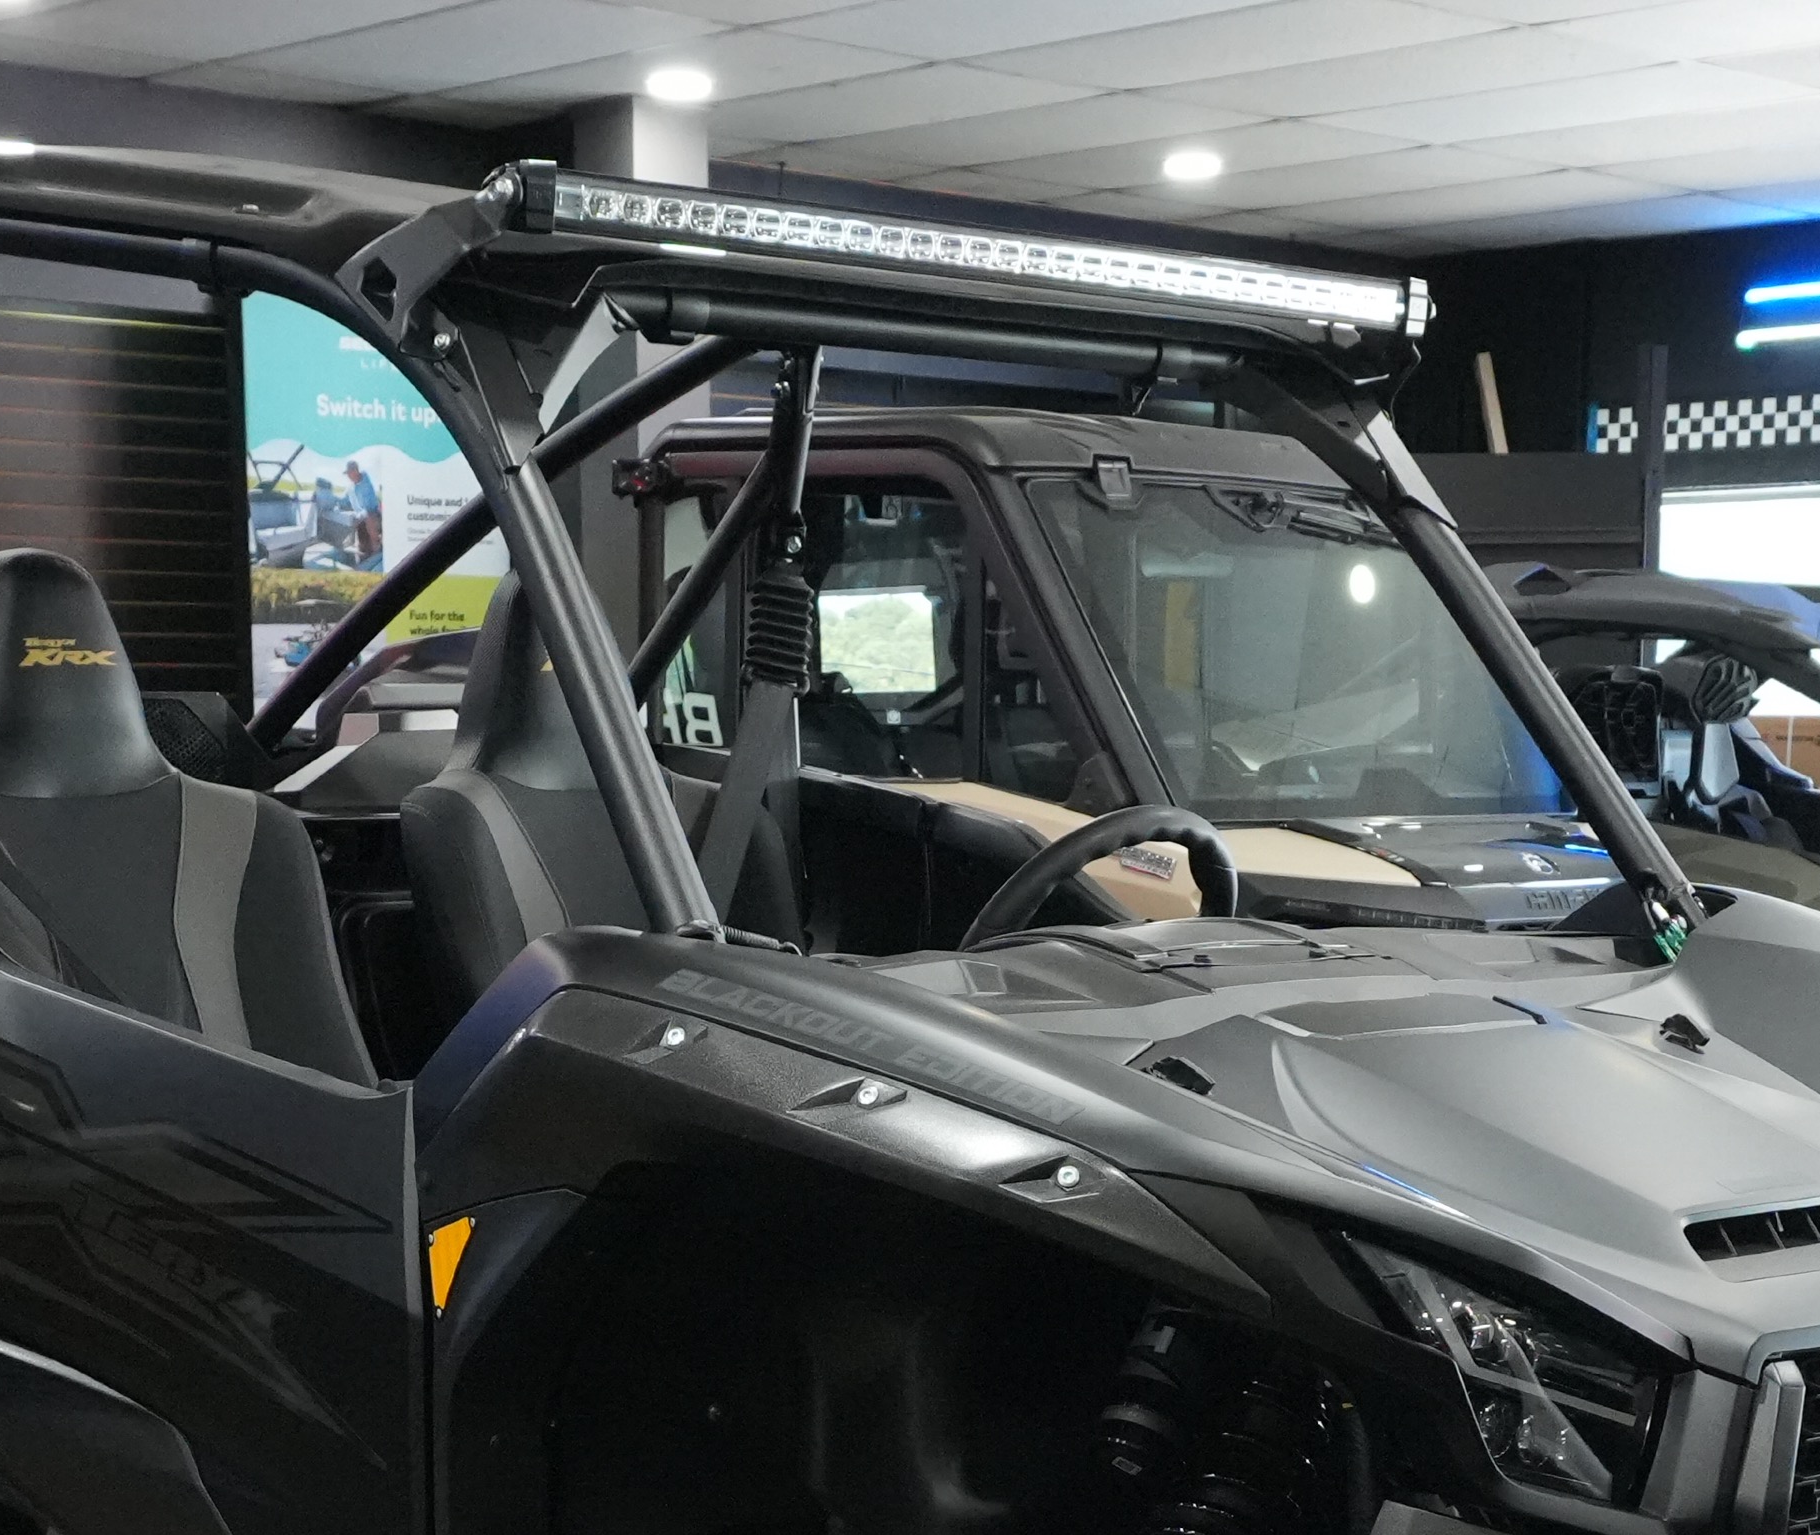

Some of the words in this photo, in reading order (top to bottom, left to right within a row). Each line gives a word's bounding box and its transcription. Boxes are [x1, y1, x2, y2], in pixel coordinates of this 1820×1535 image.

[316, 394, 386, 419] Switch
[391, 401, 406, 420] it
[407, 495, 442, 509] Unique
[445, 497, 462, 507] and
[410, 610, 428, 620] Fun
[430, 610, 446, 621] for
[448, 611, 465, 621] the
[19, 648, 117, 667] KRX
[654, 967, 898, 1052] BLACKOUT
[892, 1042, 1086, 1126] EDITION
